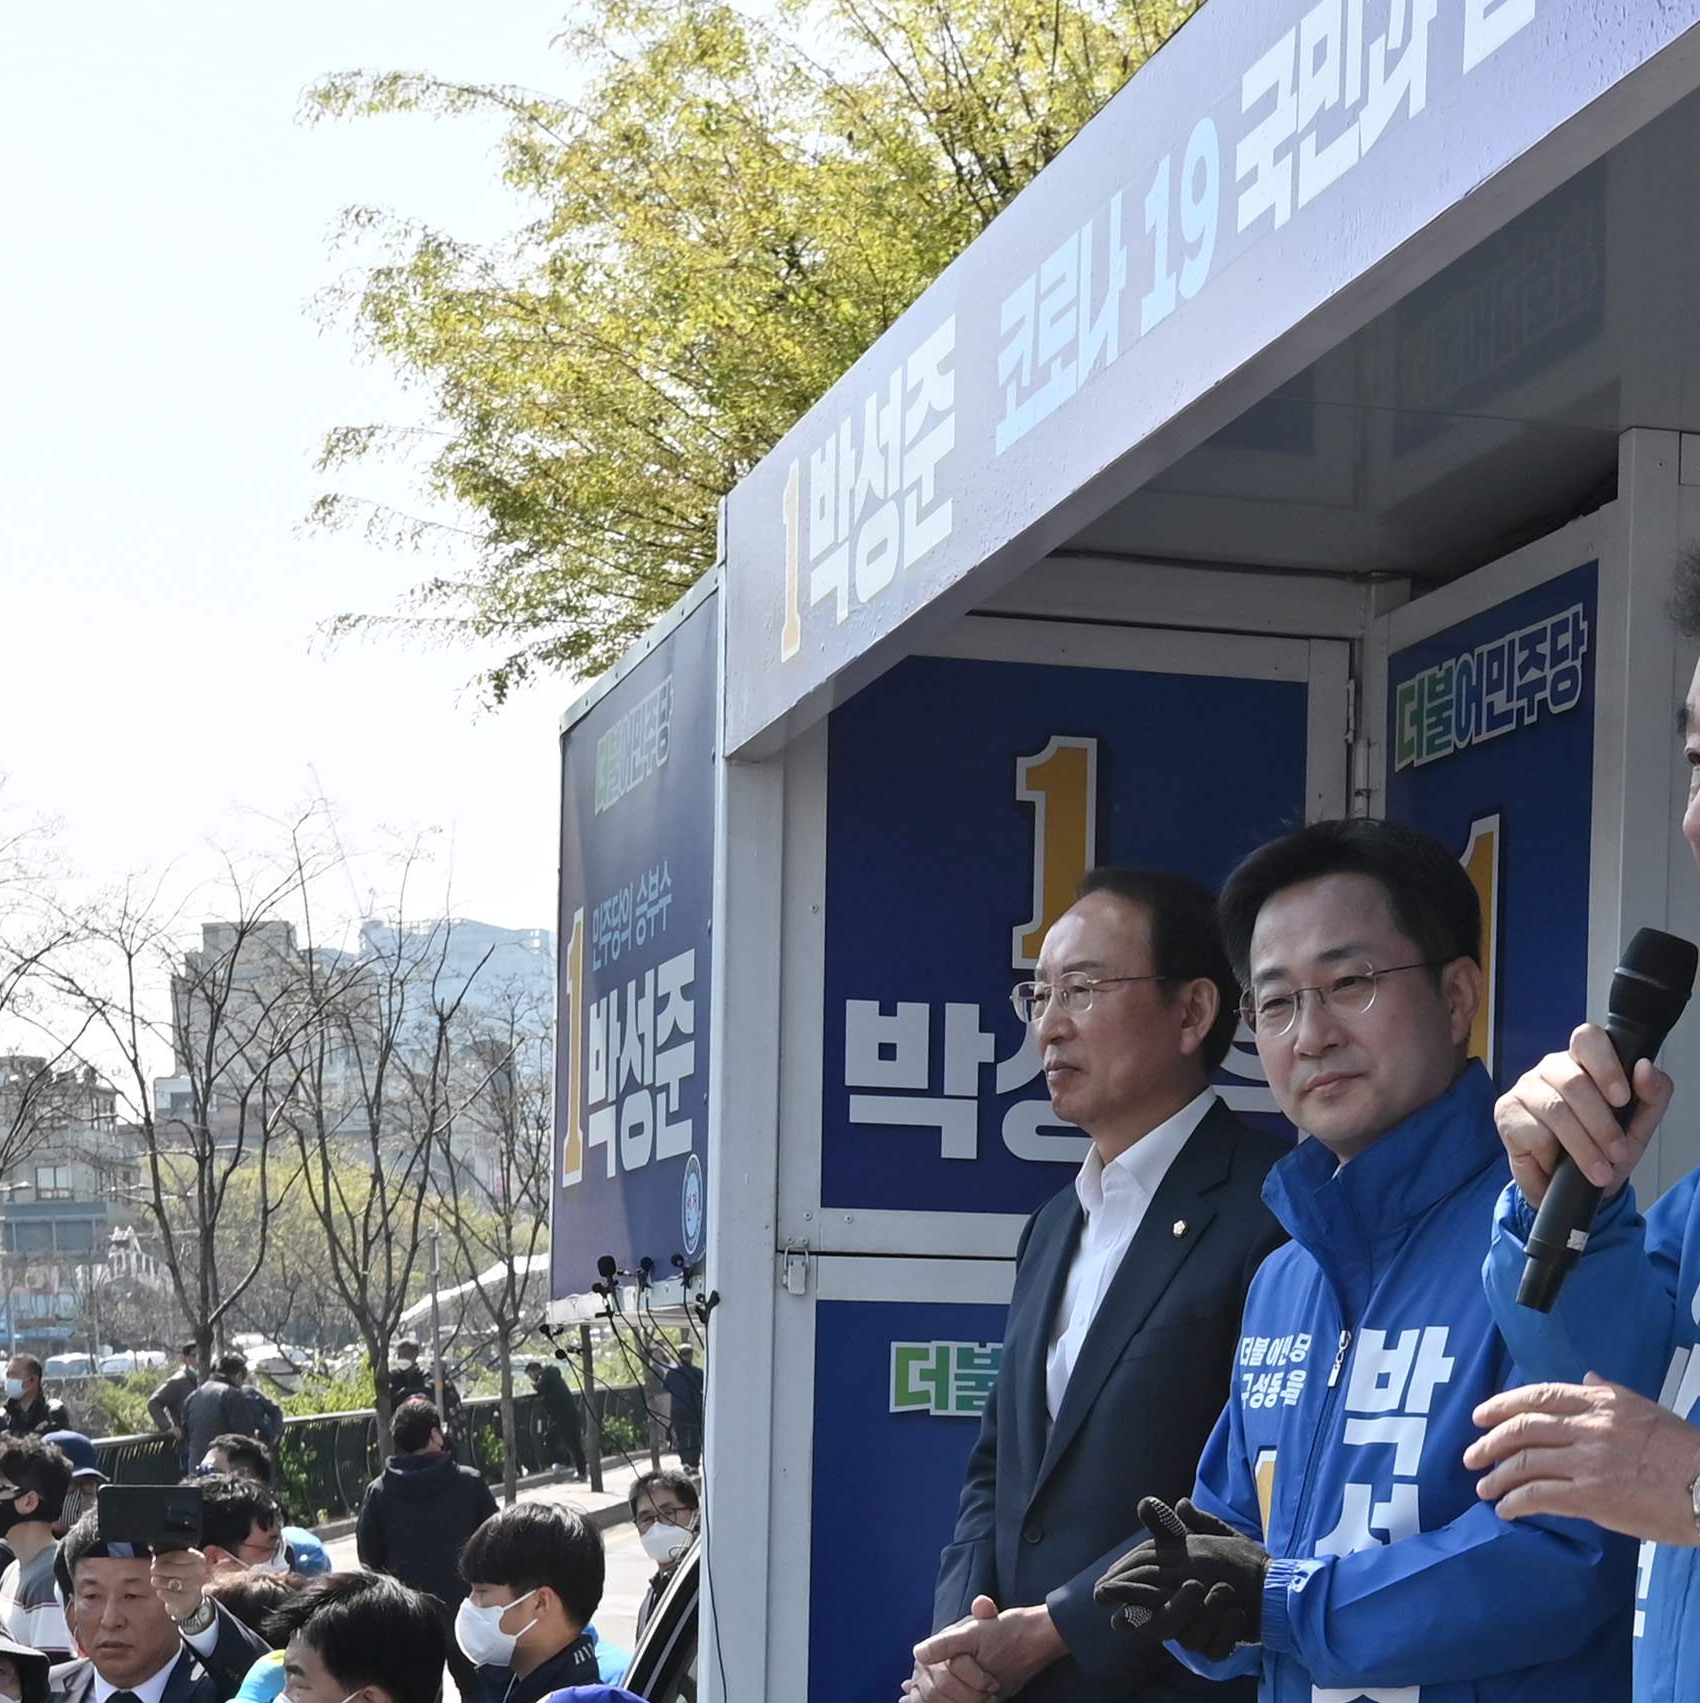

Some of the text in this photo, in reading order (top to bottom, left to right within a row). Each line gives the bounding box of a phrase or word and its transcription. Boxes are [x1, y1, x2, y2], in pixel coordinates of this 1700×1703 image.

[808, 314, 957, 627] 박성준
[995, 188, 1129, 456] 코로나
[1140, 116, 1221, 333] 19
[594, 674, 673, 816] 더불어민주당
[1394, 602, 1590, 774] 더불어민주당
[591, 858, 673, 974] 민주당의 승부수
[1011, 733, 1099, 970] 1
[561, 905, 695, 1189] 1 박성준
